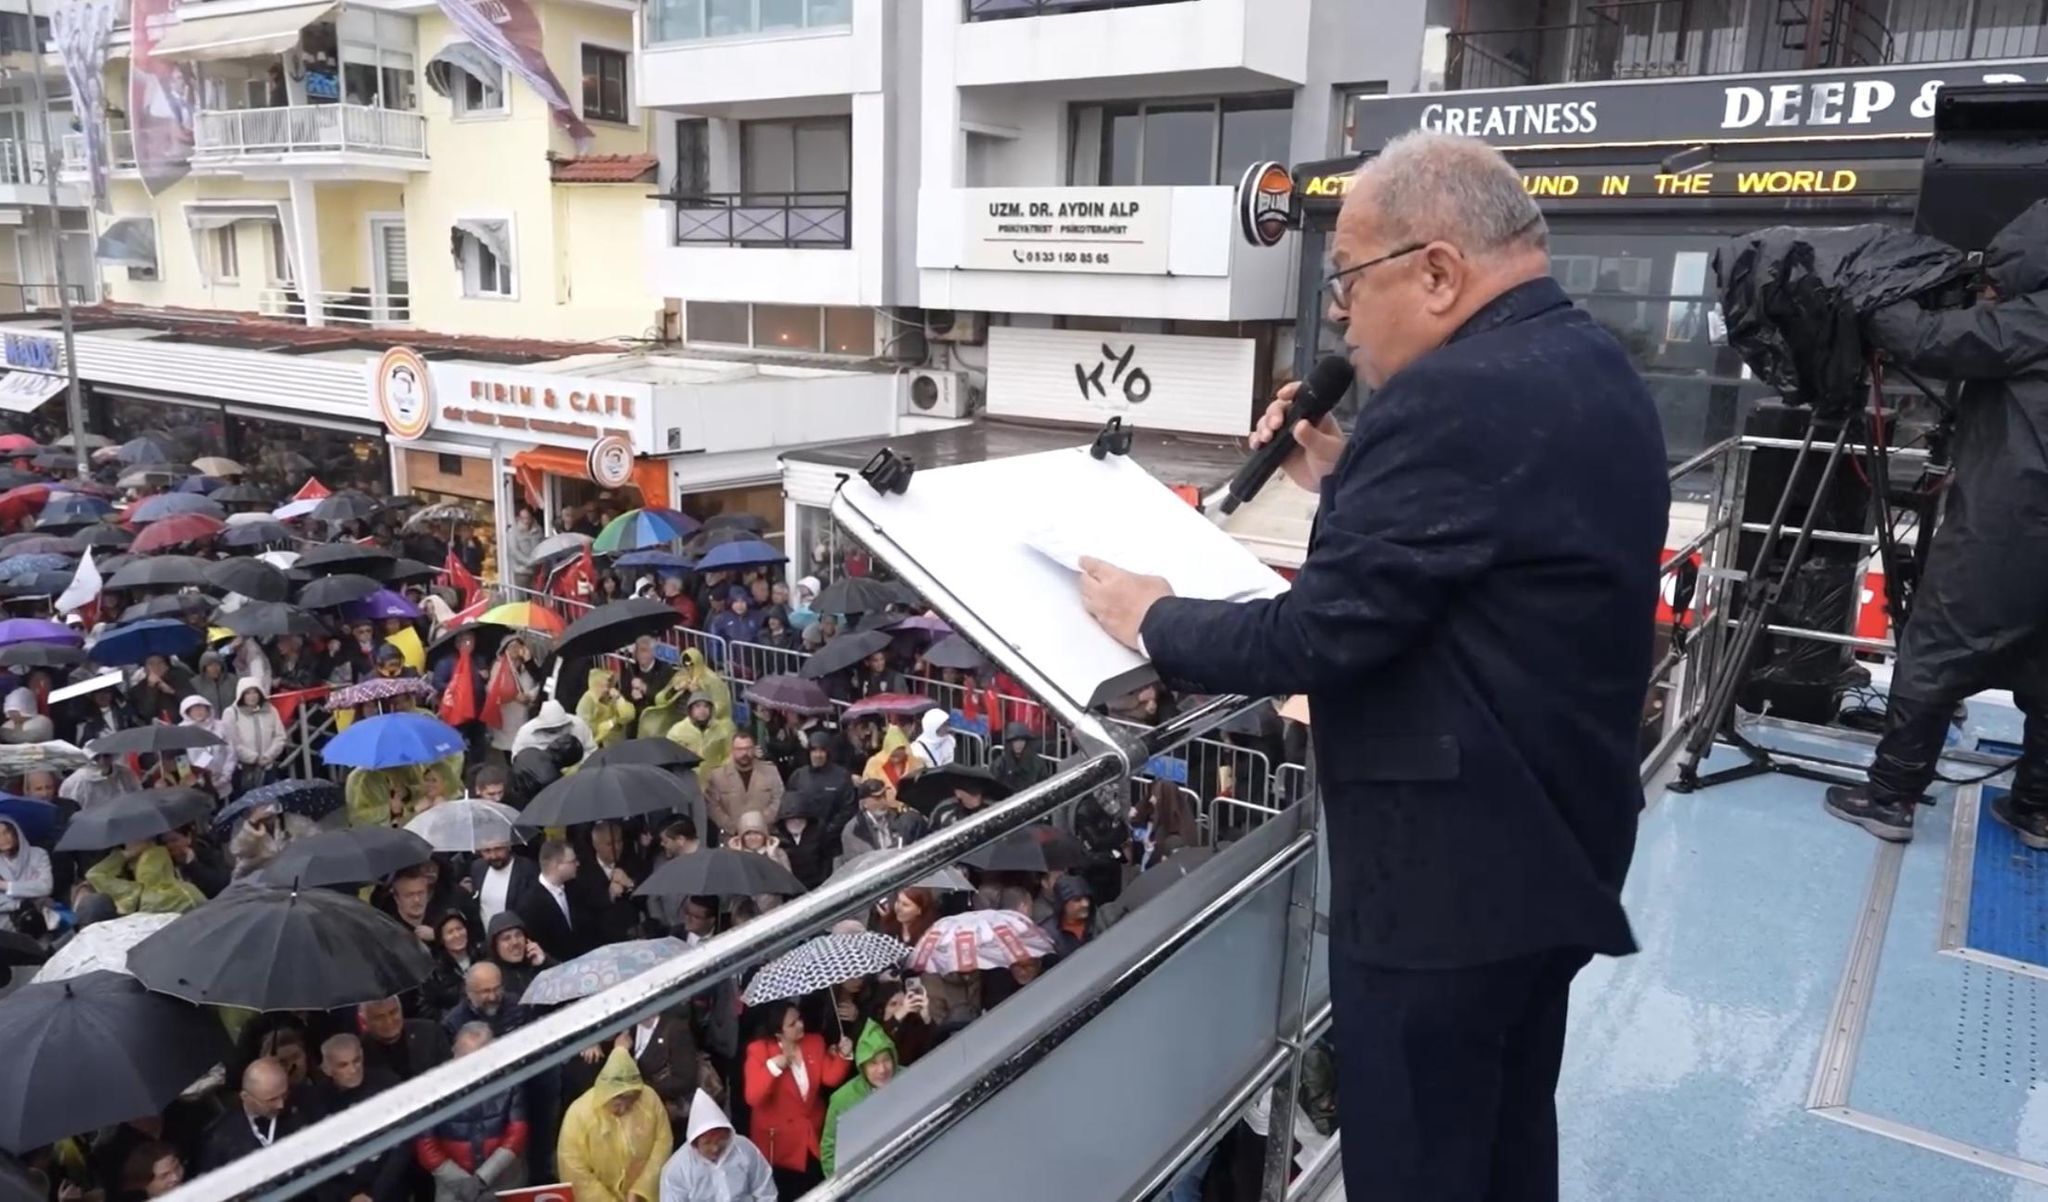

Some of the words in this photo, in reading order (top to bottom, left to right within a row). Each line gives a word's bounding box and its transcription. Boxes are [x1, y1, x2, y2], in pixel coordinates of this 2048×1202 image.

[1420, 101, 1597, 136] GREATNESS
[1721, 80, 1896, 128] DEEP
[1910, 80, 1945, 118] &
[1306, 176, 1355, 194] ACT
[1522, 175, 1579, 195] UND
[1602, 175, 1630, 195] IN
[1654, 173, 1714, 194] THE
[1737, 170, 1858, 193] WORLD
[989, 203, 1025, 217] UZM.
[1029, 203, 1053, 217] DR.
[1058, 202, 1105, 218] AYDIN
[1109, 202, 1140, 218] ALP
[1074, 342, 1152, 404] KYO
[543, 387, 559, 409] &
[569, 390, 636, 420] CAFE
